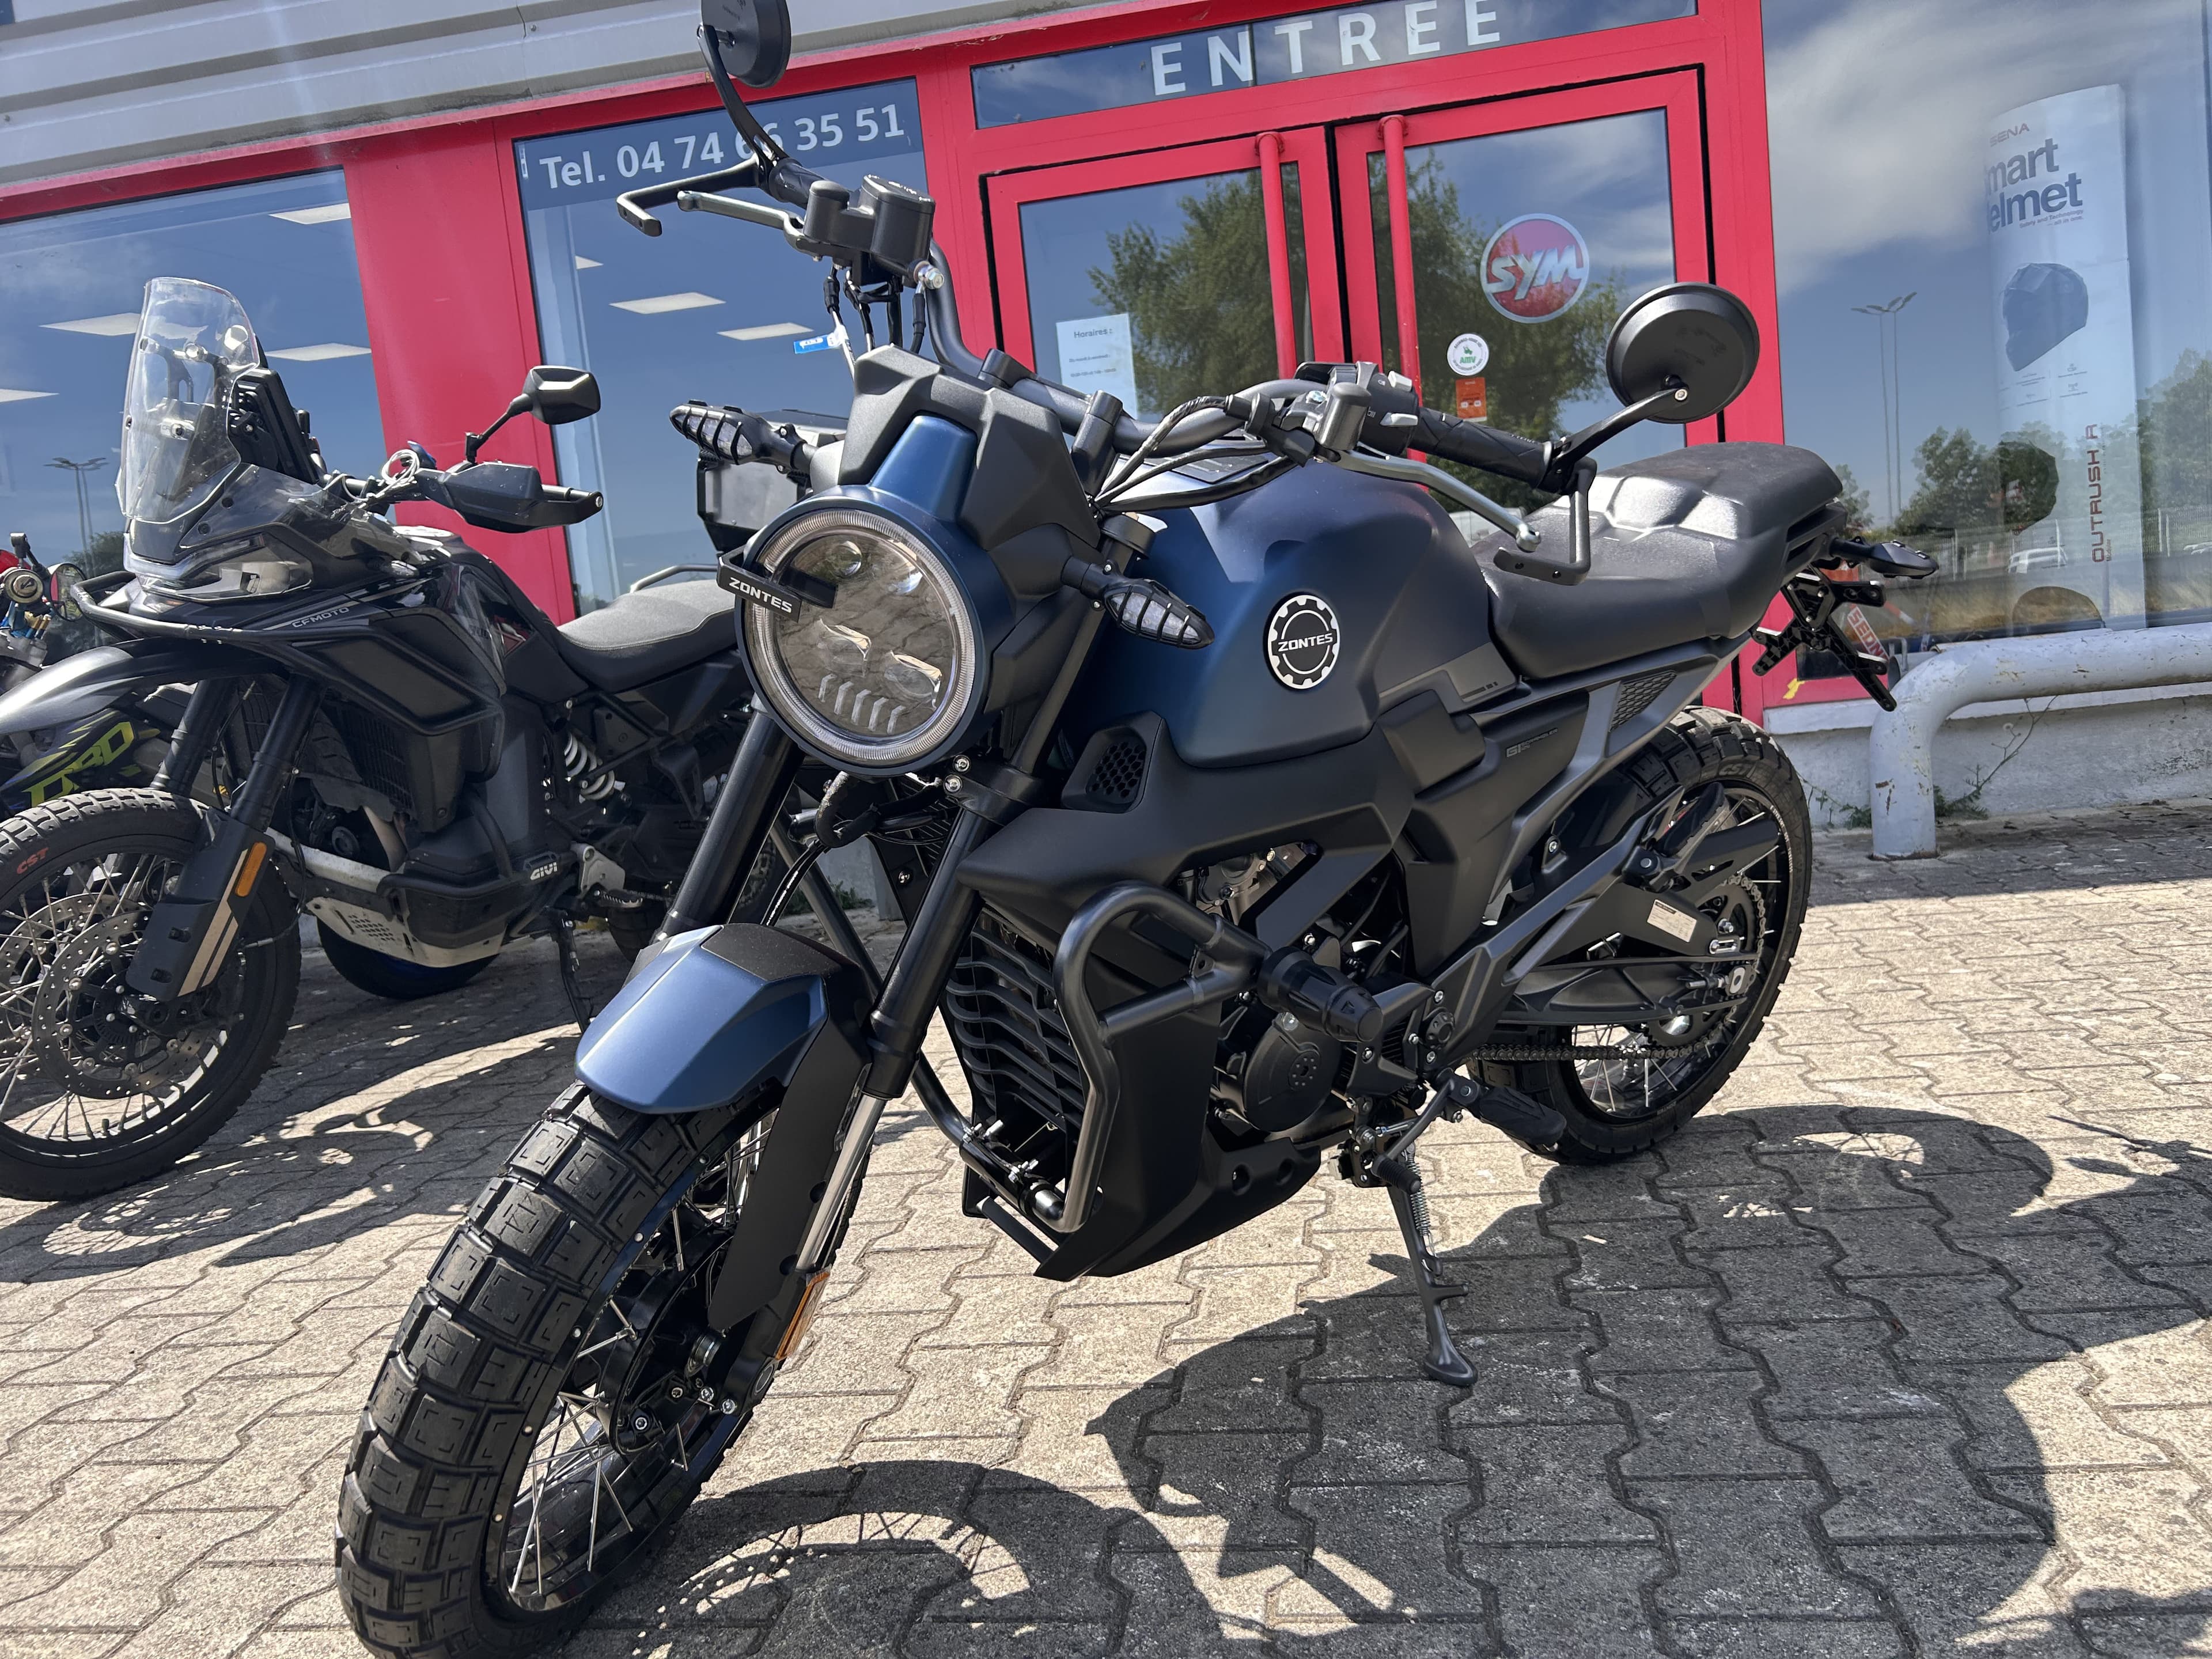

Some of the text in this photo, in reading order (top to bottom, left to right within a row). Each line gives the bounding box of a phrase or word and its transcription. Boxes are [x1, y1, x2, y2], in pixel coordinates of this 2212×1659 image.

[1151, 0, 1500, 96] ENTREE
[539, 151, 606, 189] Tel.
[617, 145, 665, 178] 04
[674, 132, 724, 169] 74
[794, 113, 843, 150] 35
[856, 104, 905, 142] 51
[1990, 123, 2030, 147] SENA
[1985, 138, 2060, 196] mart
[1988, 172, 2084, 234] elmet
[1486, 244, 1584, 301] SYM
[1074, 328, 1107, 338] Horaires
[2086, 449, 2105, 563] OUTRUSH
[729, 577, 793, 613] ZONTES
[291, 607, 350, 628] CFMOTO
[1278, 632, 1333, 652] ZONTES
[17, 847, 49, 874] CST
[530, 861, 558, 881] GIVI
